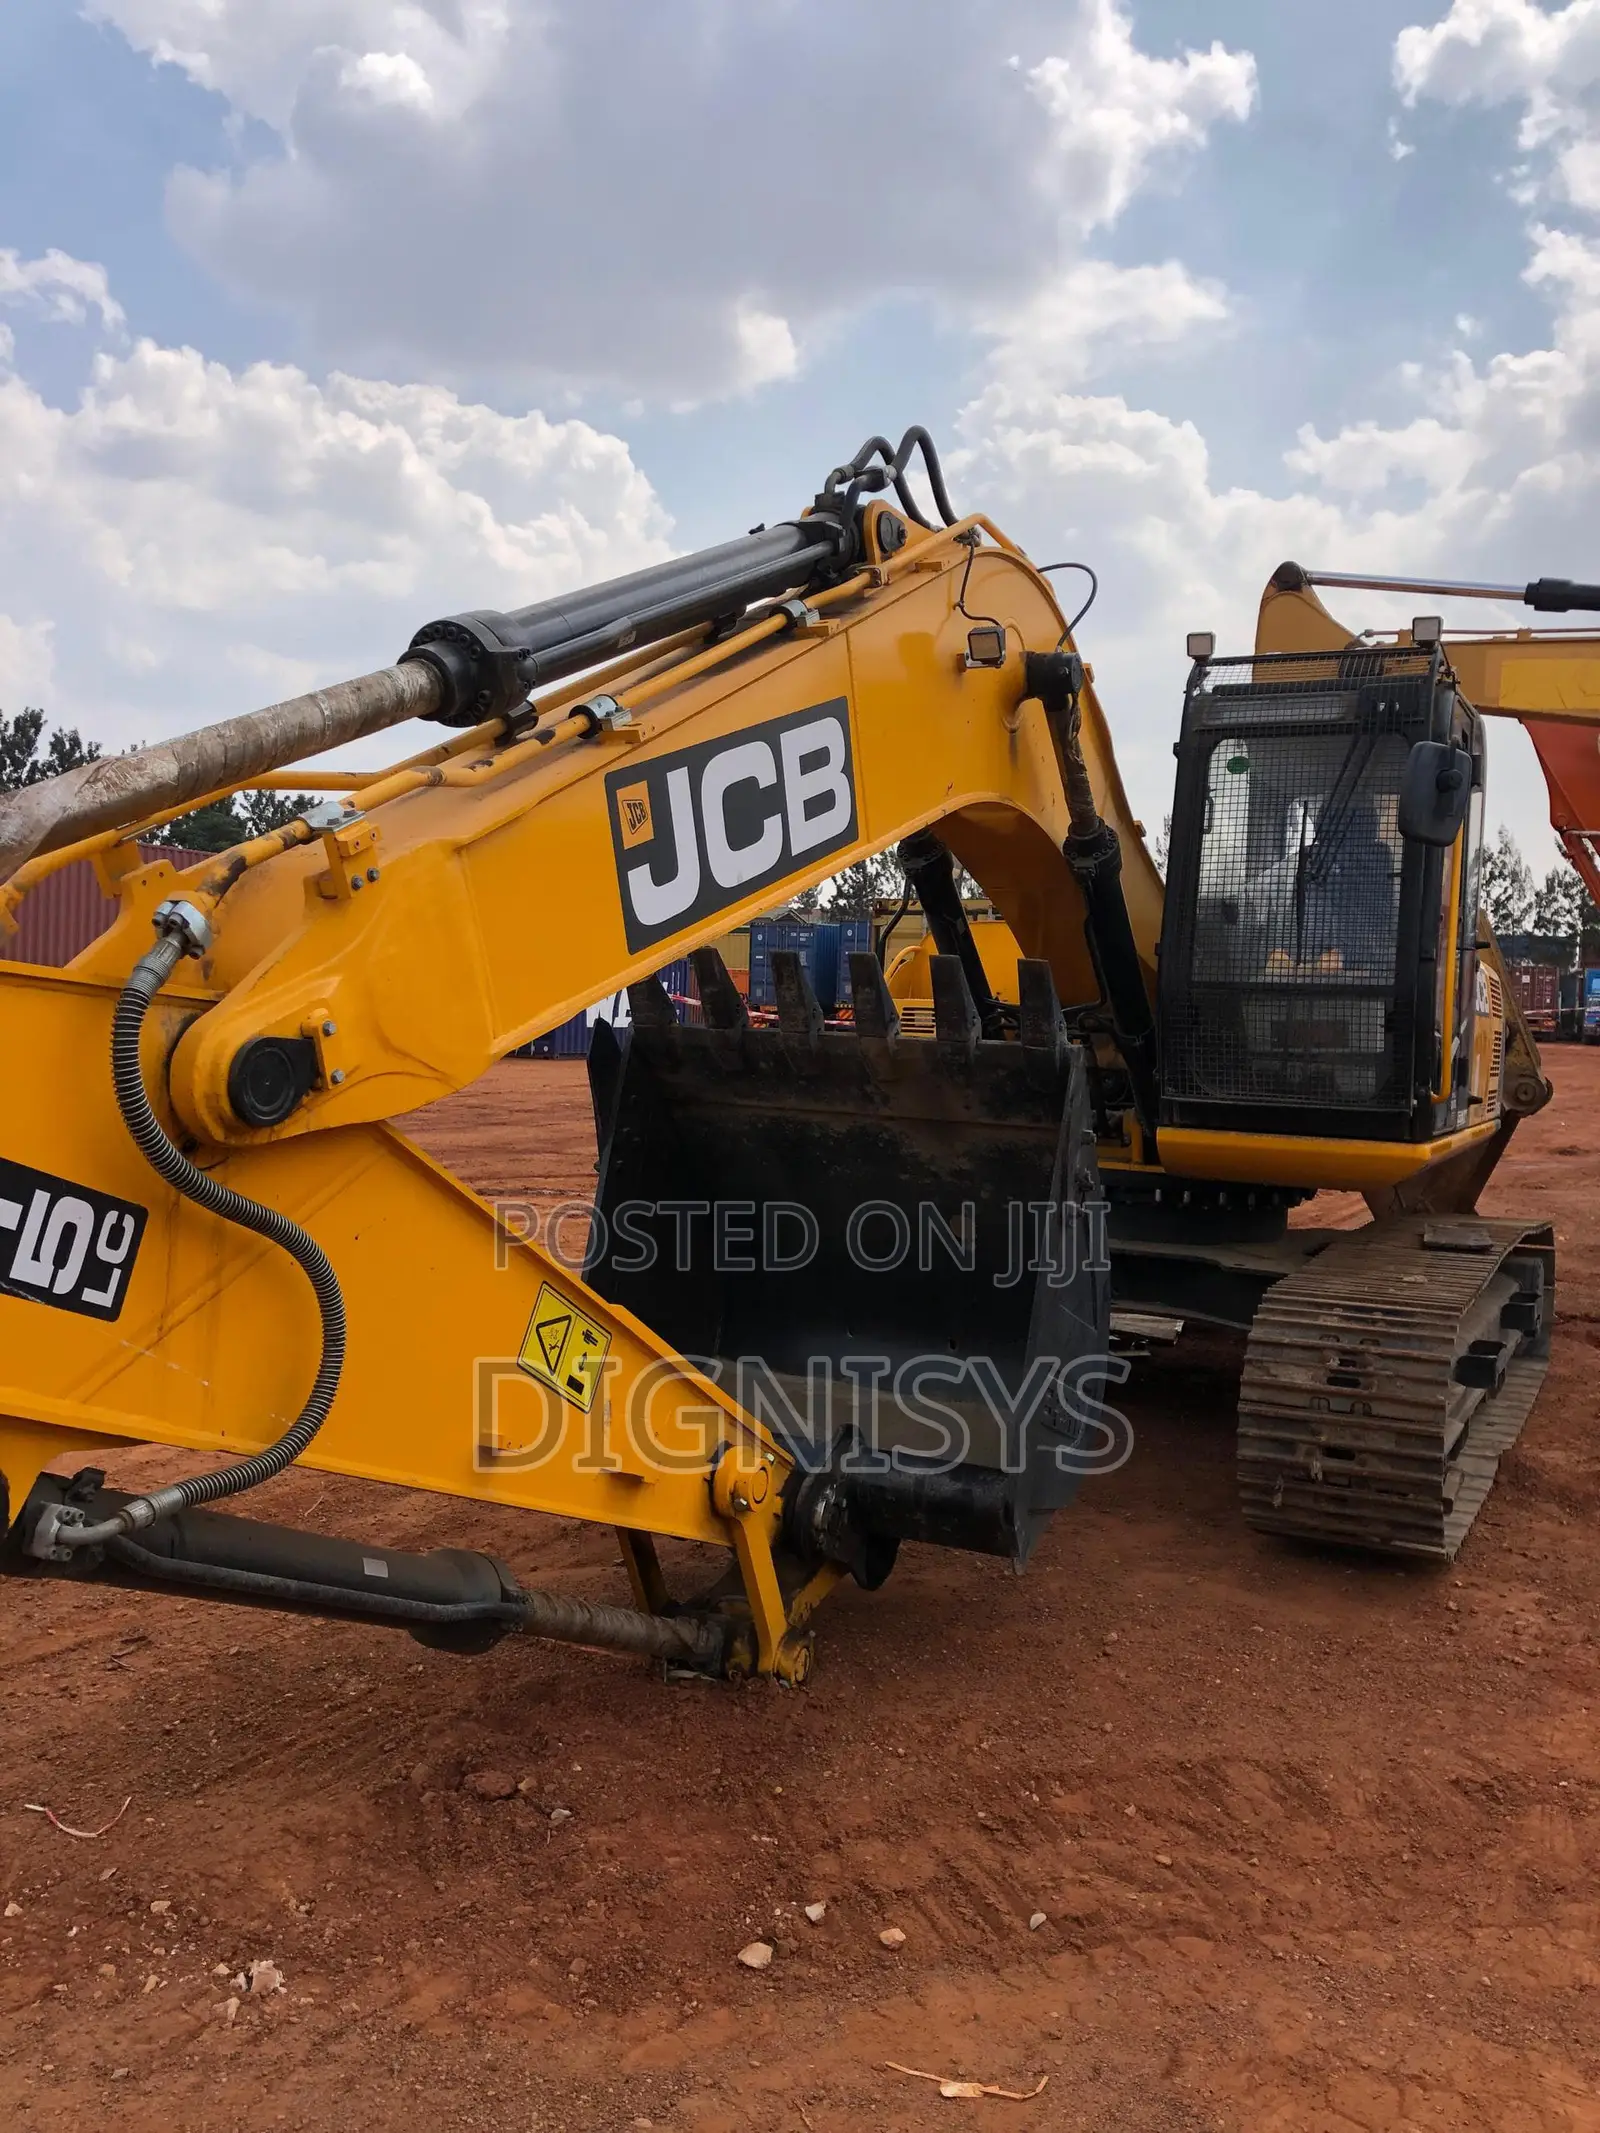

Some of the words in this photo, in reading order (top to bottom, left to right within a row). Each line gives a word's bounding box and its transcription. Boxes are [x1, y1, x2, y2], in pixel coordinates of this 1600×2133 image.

[626, 802, 647, 830] JCB
[627, 716, 851, 926] JCB
[81, 1210, 135, 1308] LC
